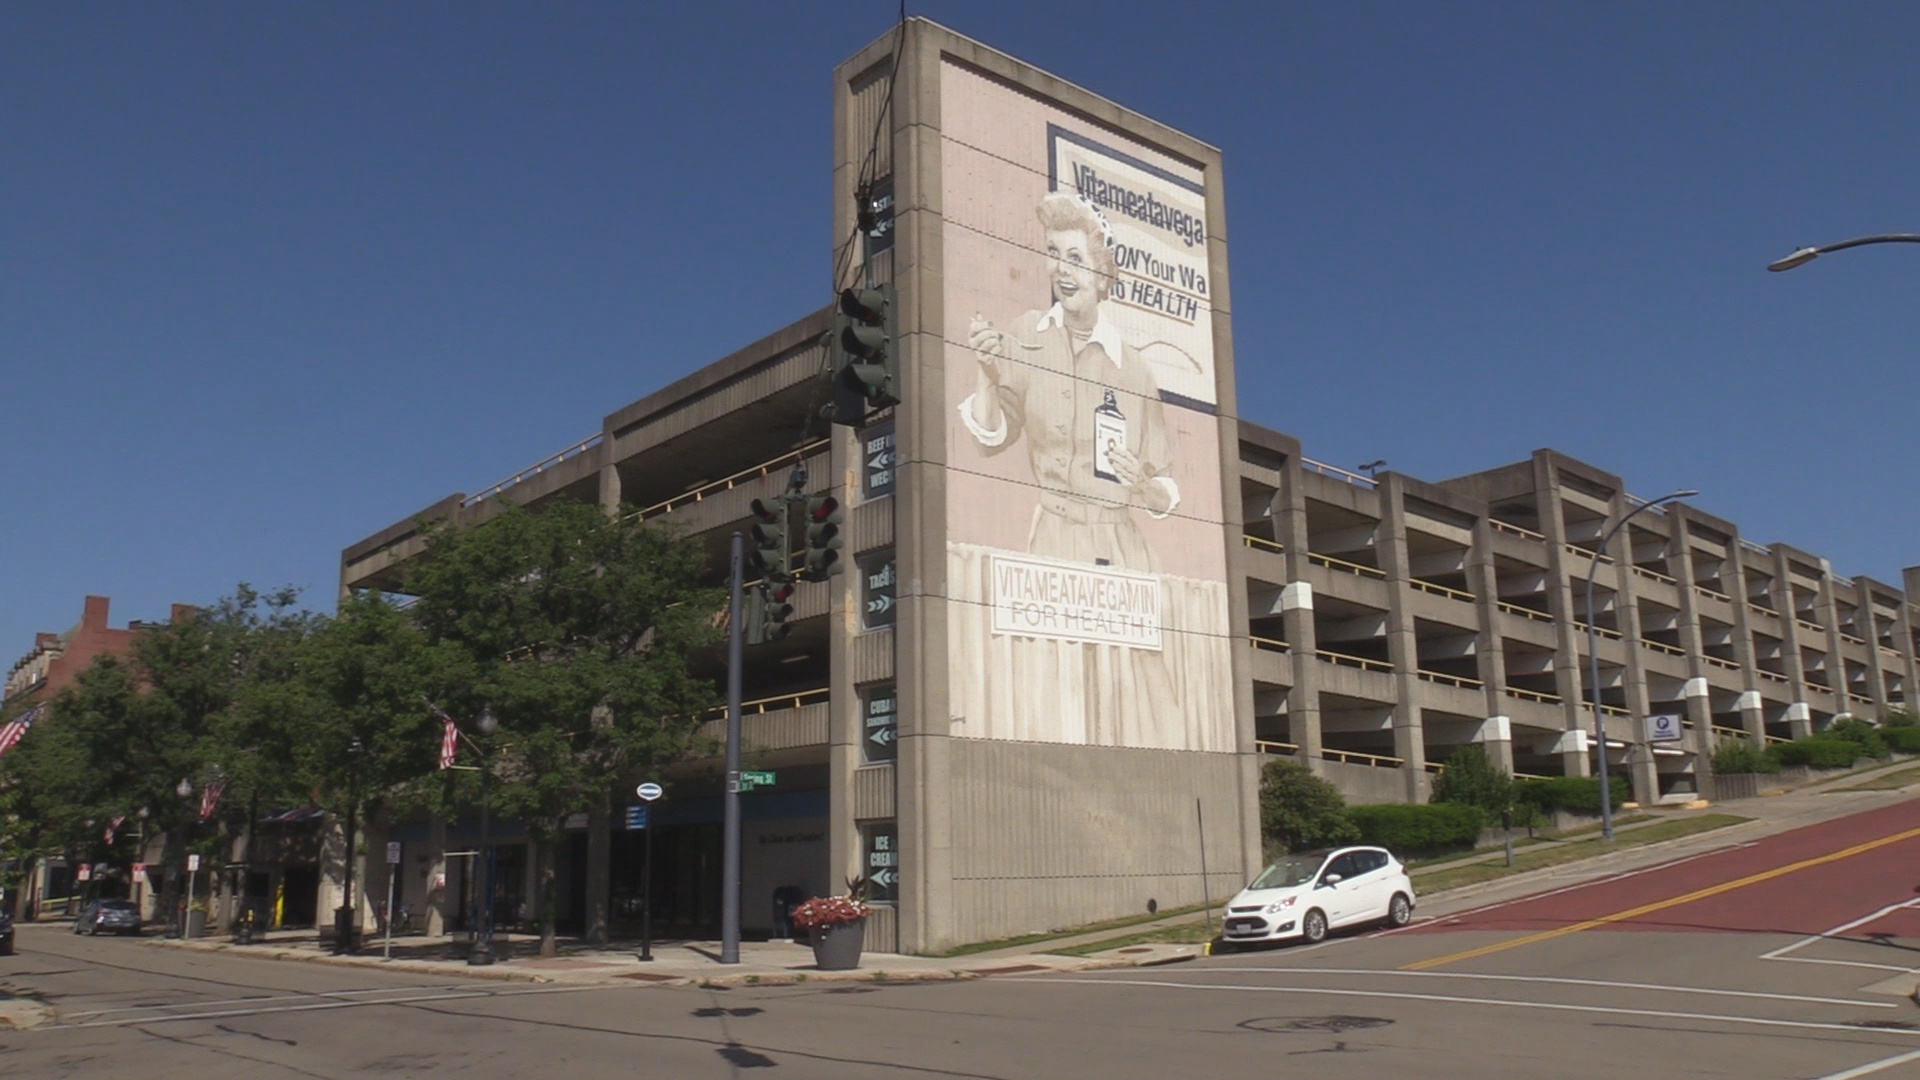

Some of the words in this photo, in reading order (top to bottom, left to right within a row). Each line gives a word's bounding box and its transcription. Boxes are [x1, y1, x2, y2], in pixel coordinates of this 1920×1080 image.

[1131, 280, 1198, 321] HEALTH
[867, 436, 886, 455] BEEF
[998, 564, 1155, 614] VITAMEATAVEGAMIN
[1012, 602, 1057, 628] FOR
[875, 836, 889, 850] ICE
